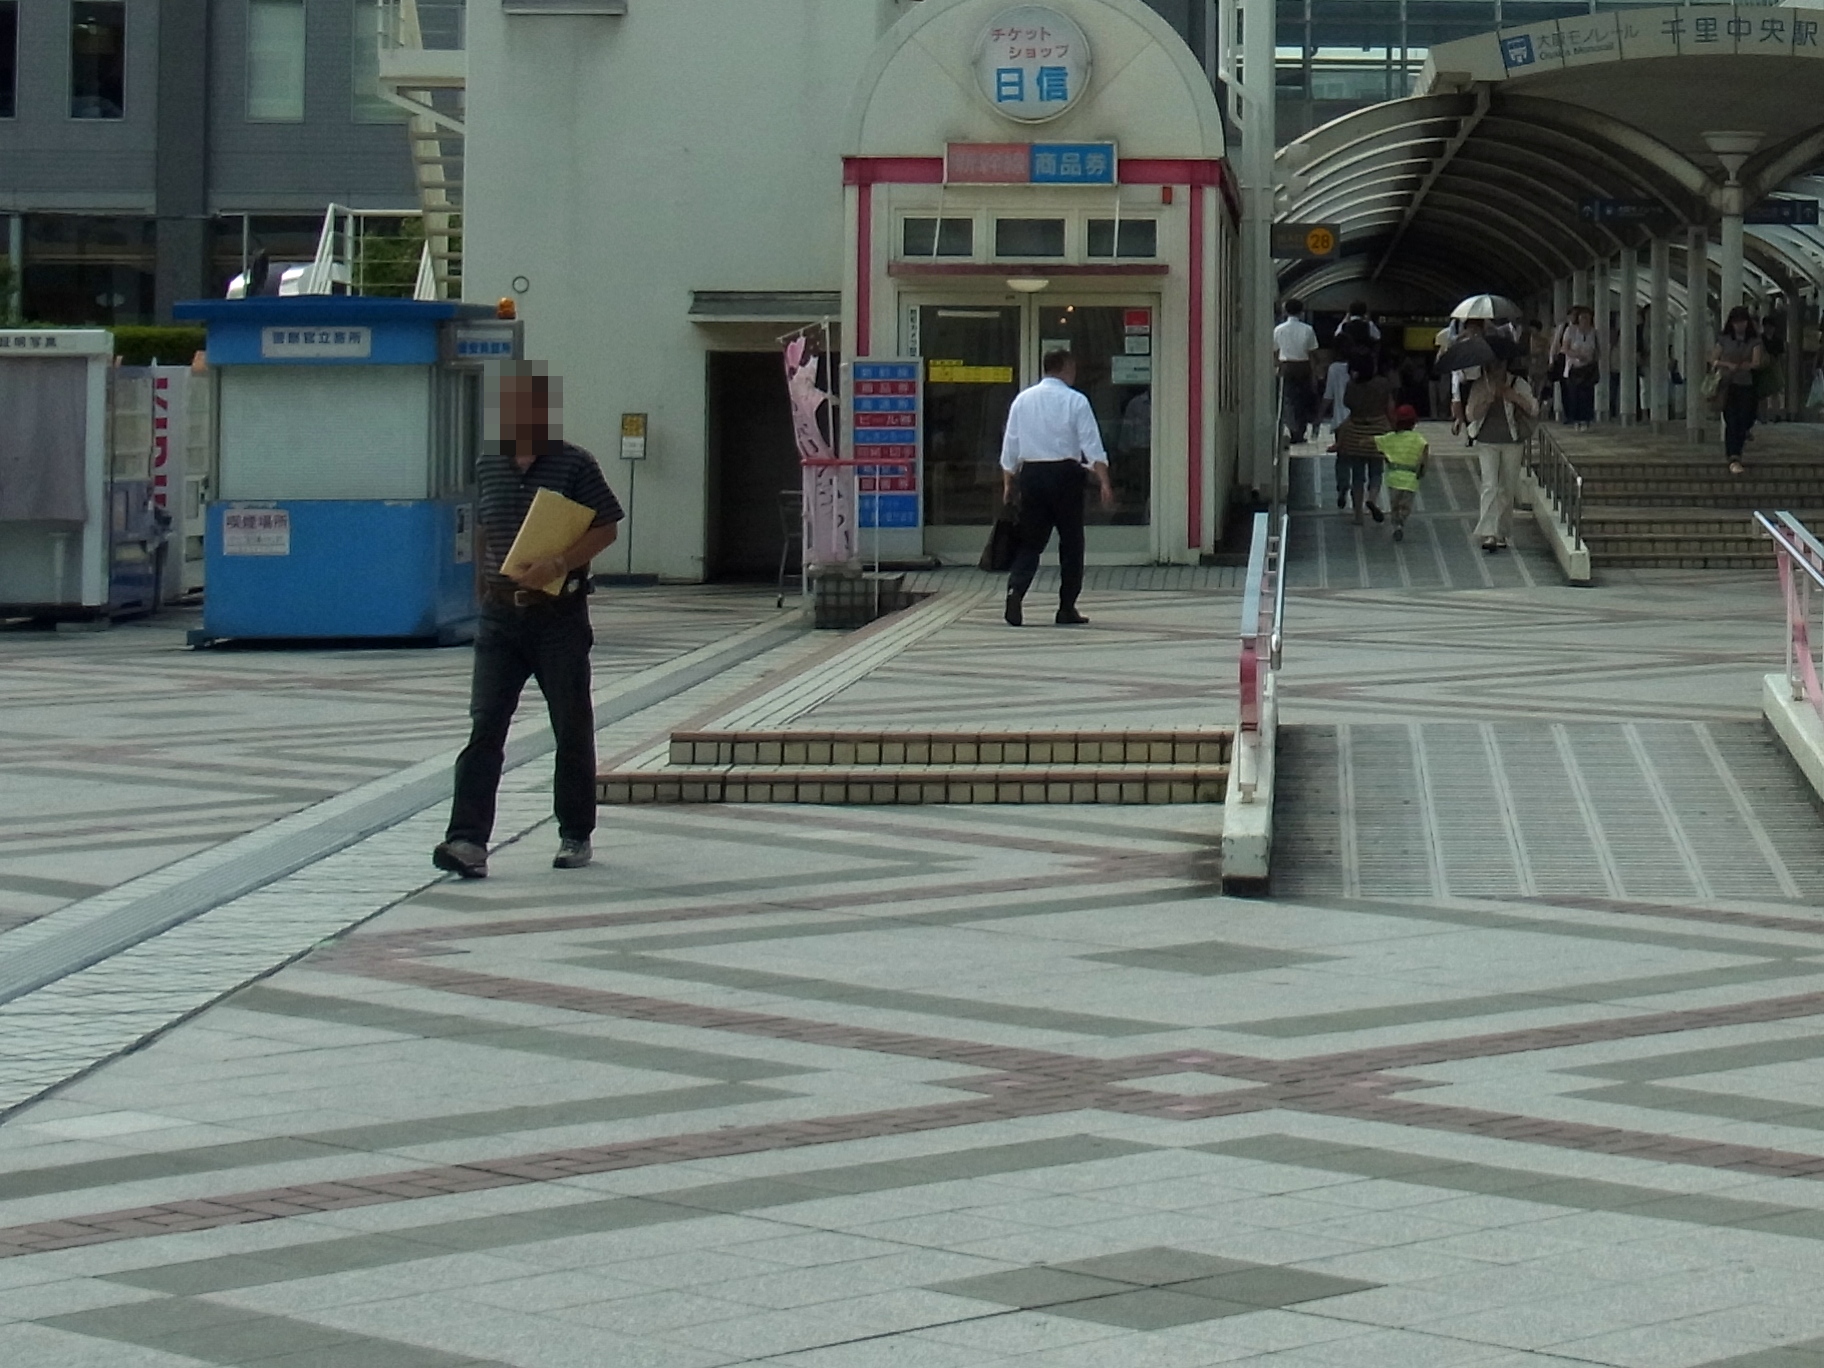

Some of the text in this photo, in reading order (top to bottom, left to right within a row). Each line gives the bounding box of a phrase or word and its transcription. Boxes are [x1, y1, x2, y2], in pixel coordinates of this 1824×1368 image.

[991, 27, 1052, 42] チケット
[1537, 17, 1819, 49] 大阪モノレール 千里中央駅
[1008, 45, 1070, 60] ショップ
[996, 65, 1069, 102] 日信
[1035, 152, 1108, 175] 商品券
[1310, 234, 1330, 249] 28
[226, 514, 288, 530] 喫煙場所
